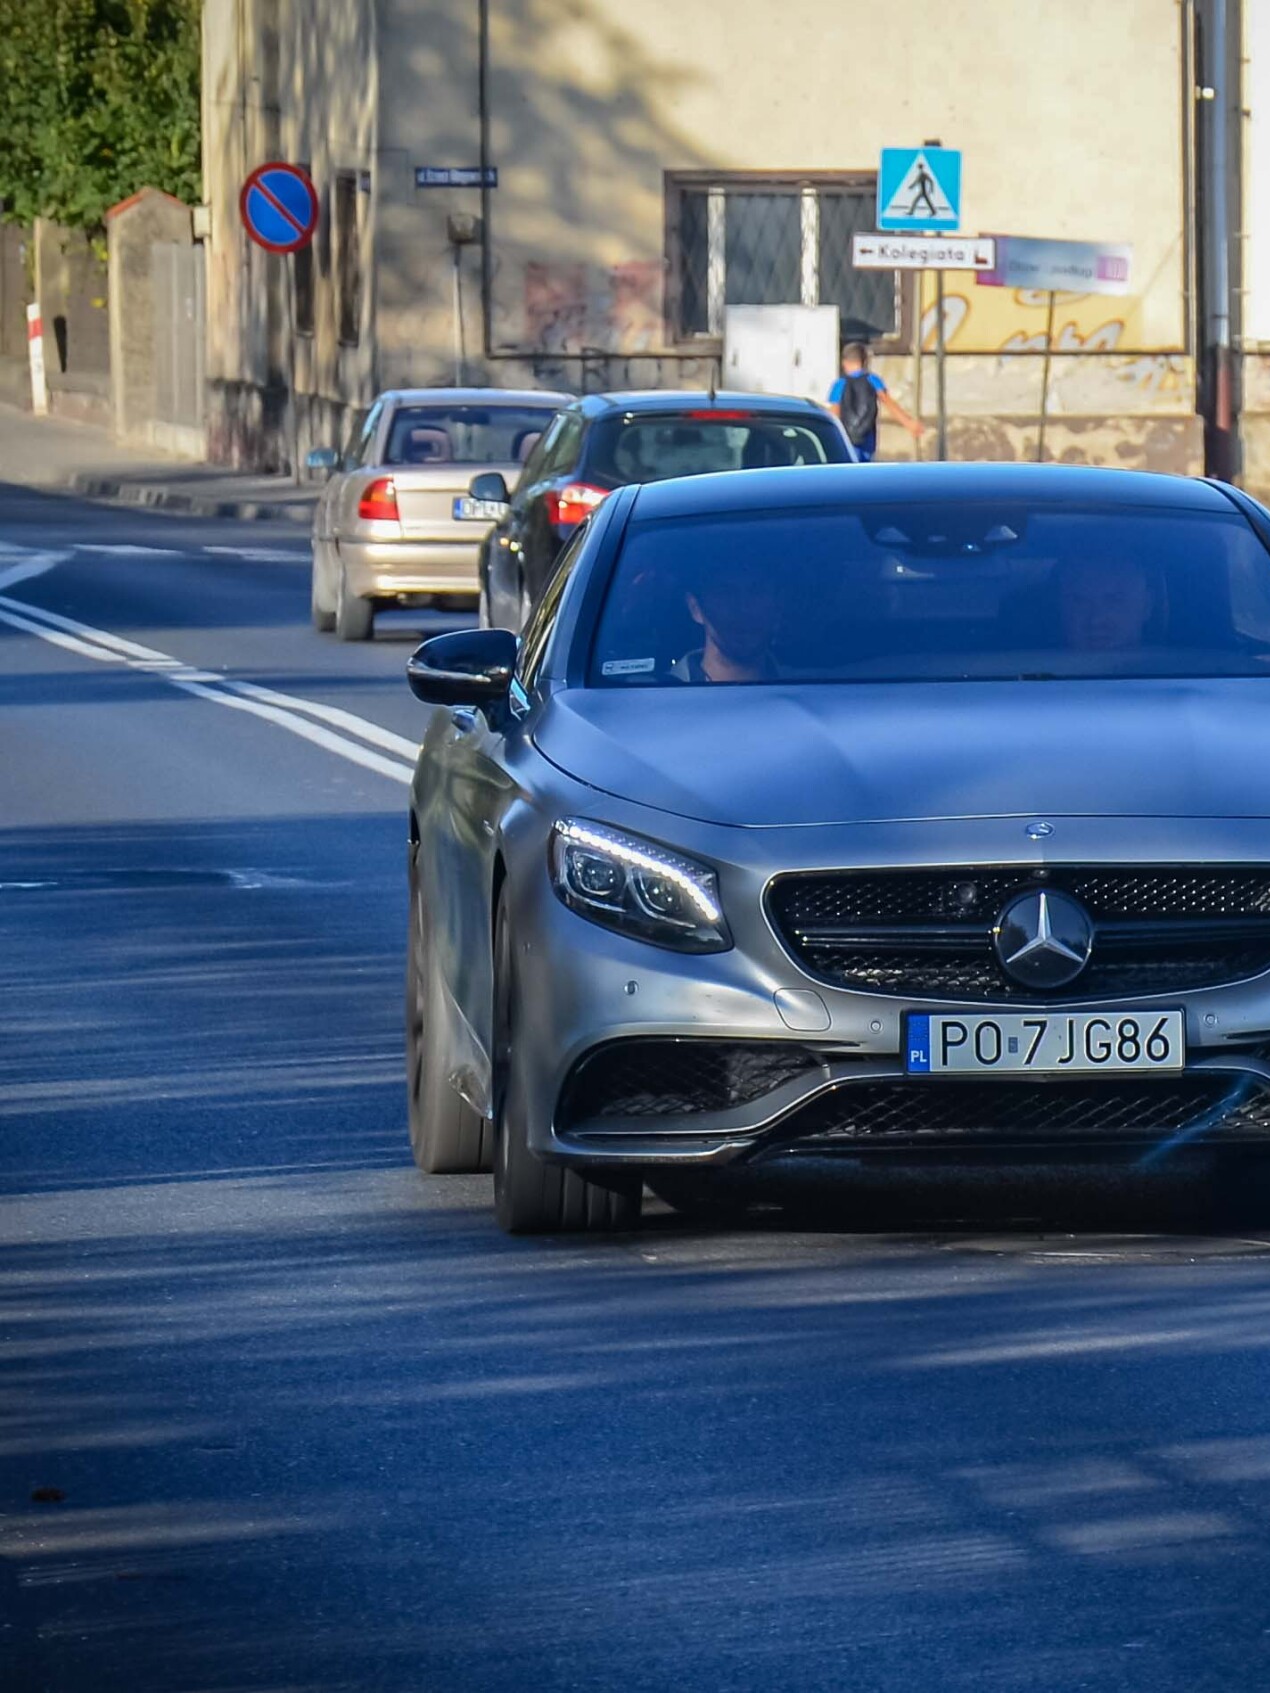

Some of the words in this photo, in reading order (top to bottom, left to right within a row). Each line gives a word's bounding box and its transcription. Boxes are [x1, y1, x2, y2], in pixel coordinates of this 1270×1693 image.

[878, 245, 965, 263] Kolegiata
[941, 1020, 1001, 1066] PO
[1023, 1017, 1170, 1065] 7JG86
[910, 1050, 927, 1063] PL
